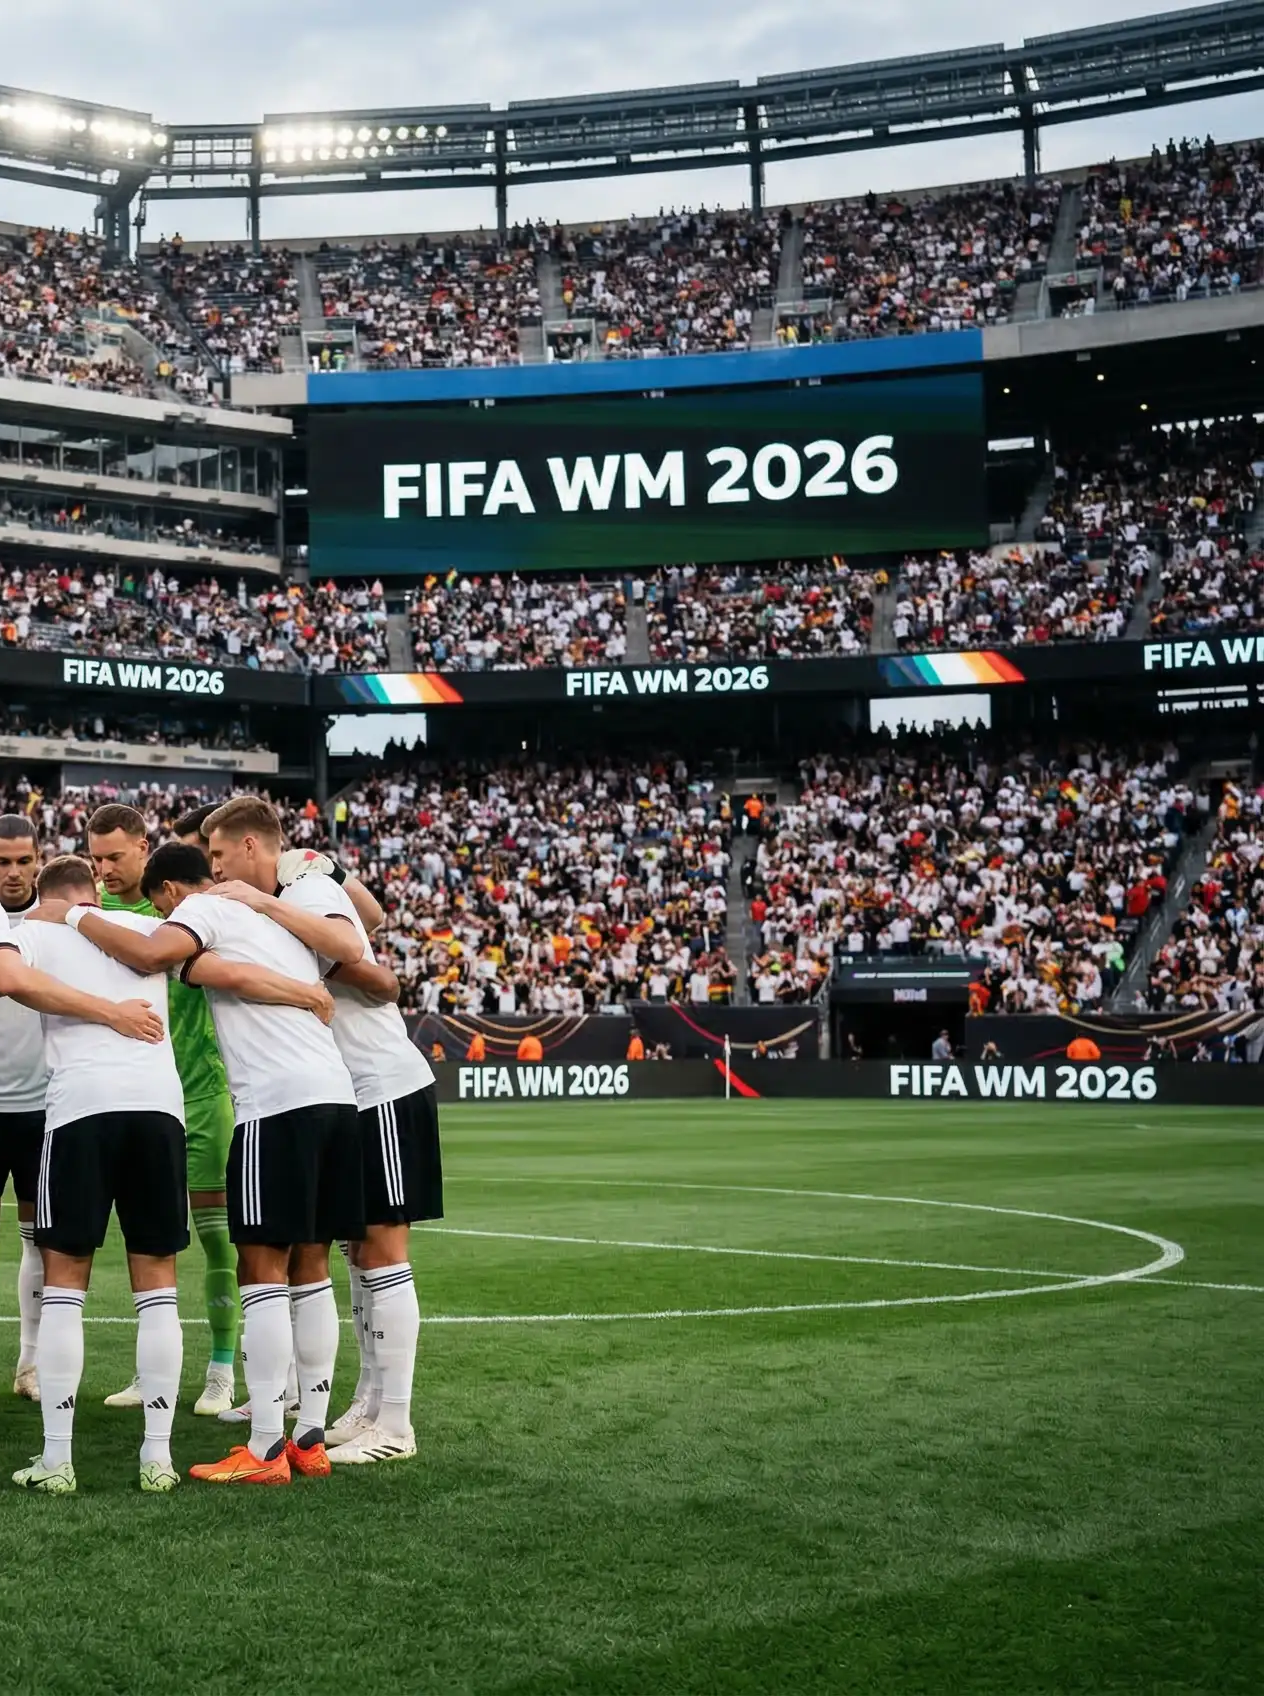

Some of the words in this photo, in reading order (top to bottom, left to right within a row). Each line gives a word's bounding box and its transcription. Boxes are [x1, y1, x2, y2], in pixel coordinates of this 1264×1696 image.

[383, 459, 536, 519] FIFA
[546, 450, 685, 512] WM
[706, 434, 898, 504] 2026
[1143, 640, 1216, 670] FIFA
[1221, 636, 1264, 664] W
[63, 658, 116, 687] FIFA
[117, 663, 162, 690] WM
[165, 666, 225, 695] 2026
[566, 671, 629, 697] FIFA
[632, 668, 688, 694] WM
[694, 665, 769, 692] 2026
[458, 1066, 514, 1099] FIFA
[516, 1065, 564, 1097] WM
[567, 1064, 630, 1096] 2026
[890, 1064, 969, 1096] FIFA
[974, 1065, 1046, 1098] WM
[1055, 1065, 1157, 1100] 2026
